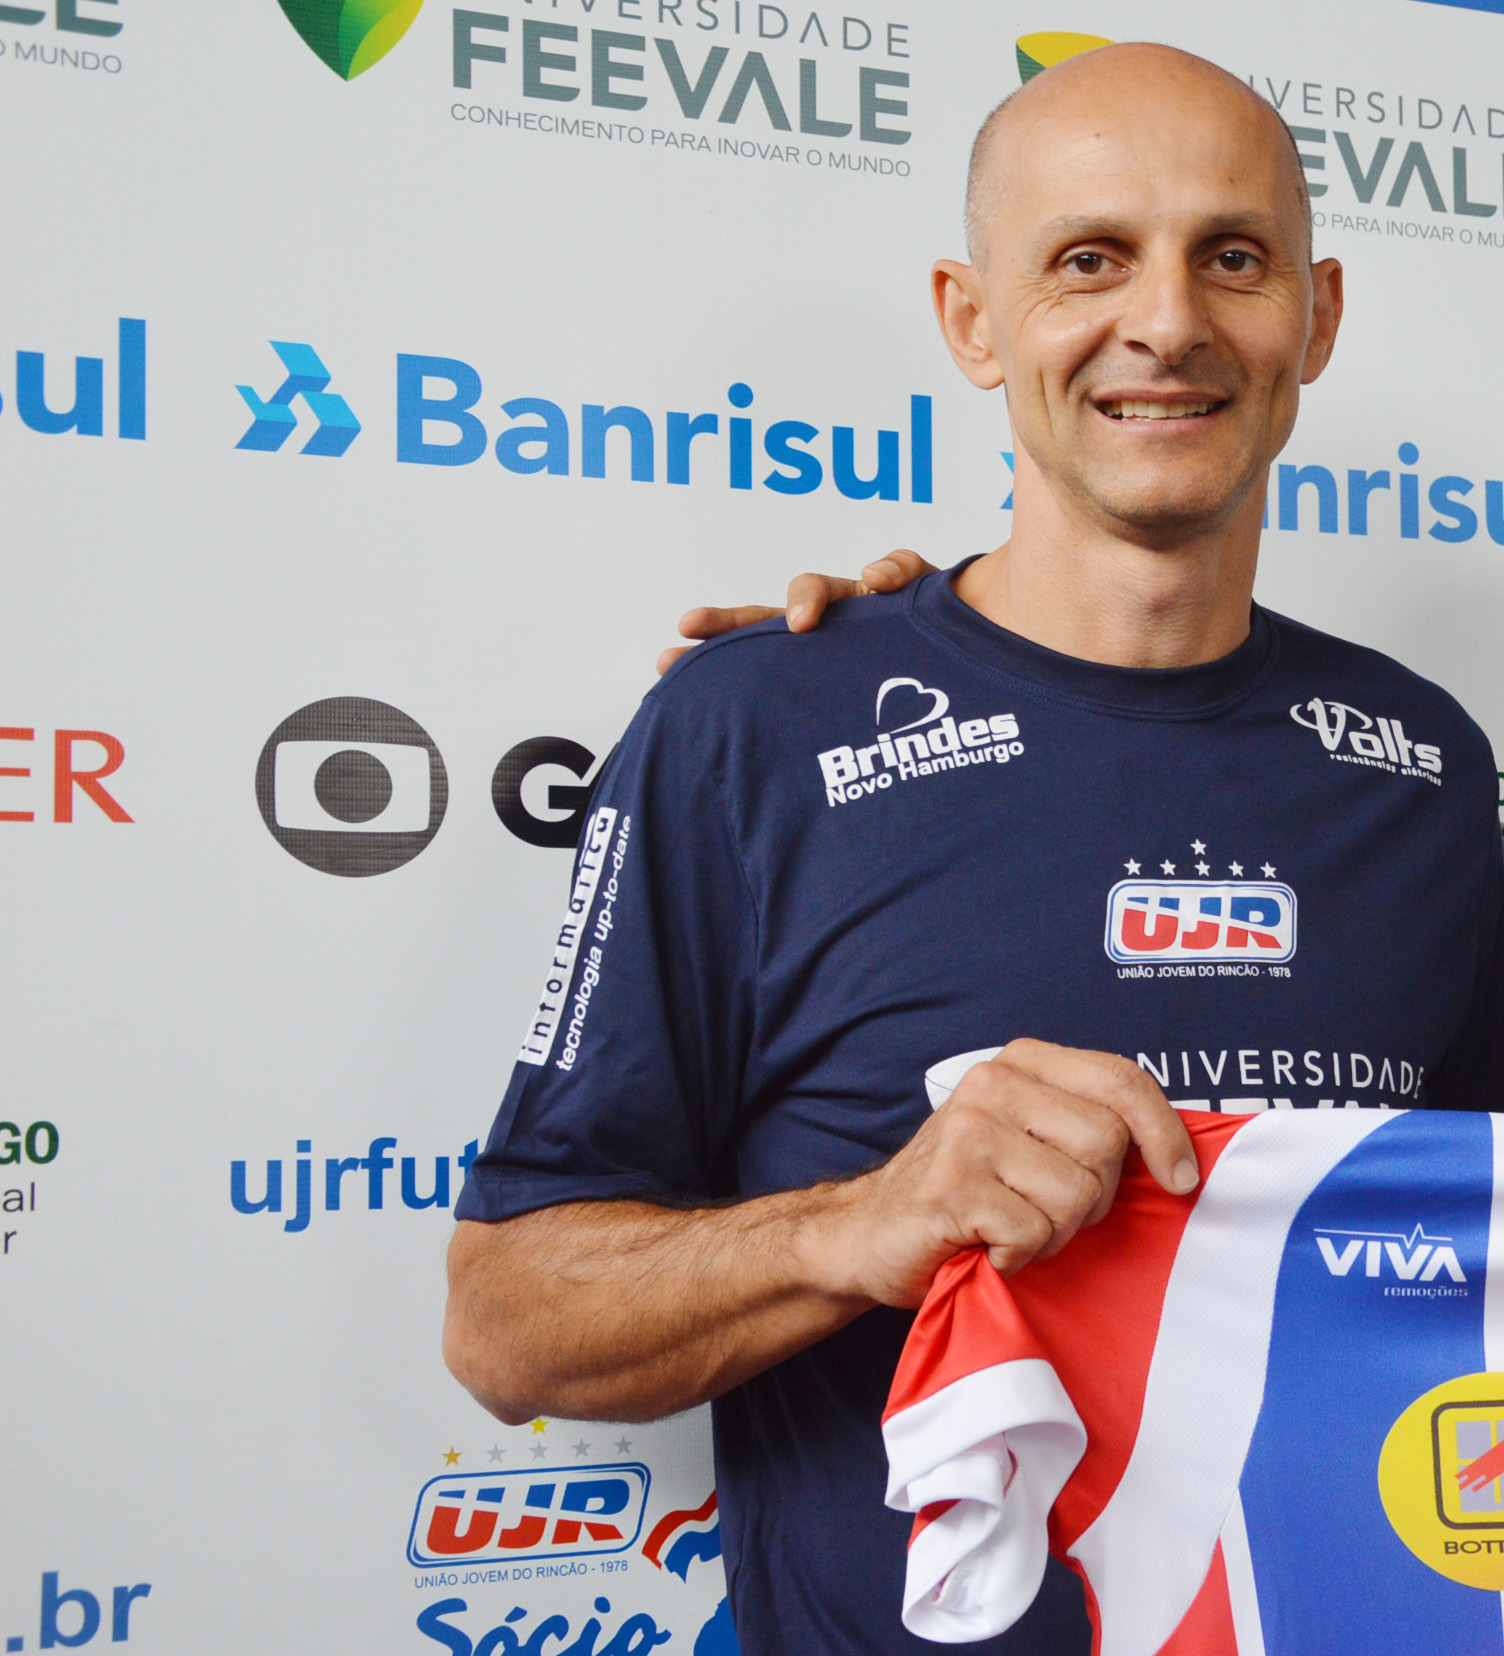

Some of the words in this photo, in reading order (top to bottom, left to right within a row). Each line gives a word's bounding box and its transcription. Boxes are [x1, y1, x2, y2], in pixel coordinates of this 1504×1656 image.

[15, 41, 122, 73] MUNDO
[452, 8, 912, 146] FEEVALE
[450, 103, 645, 144] CONHECIMENTO
[650, 129, 712, 153] PARA
[717, 138, 800, 164] INOVAR
[805, 149, 823, 166] O
[828, 151, 911, 177] MUNDO
[1331, 215, 1381, 234] PARA
[1386, 220, 1454, 242] INOVAR
[1459, 229, 1473, 244] O
[0, 317, 147, 441] ul
[396, 352, 933, 505] Banrisul
[817, 713, 1020, 788] Brindes
[1306, 697, 1442, 774] Volts
[826, 772, 893, 807] Novo
[897, 741, 1024, 781] Hamburgo
[556, 946, 604, 1072] tecnologia
[594, 815, 632, 941] up-to-date
[1121, 896, 1282, 952] UJR
[1117, 965, 1154, 979] UNIÃO
[1157, 965, 1196, 978] JOVEM
[1199, 966, 1215, 977] DO
[1218, 964, 1260, 977] RINCÃO
[1268, 966, 1291, 978] 1978
[1118, 1049, 1424, 1099] NIVERSIDADE
[1316, 1237, 1468, 1283] VIVA
[1384, 1285, 1469, 1300] remoções
[426, 1478, 631, 1555] UJR
[414, 1571, 458, 1589] UNIÃO
[461, 1569, 509, 1585] JOVEM
[512, 1567, 533, 1581] DO
[536, 1561, 588, 1578] RINCÃO
[599, 1560, 629, 1574] 1978
